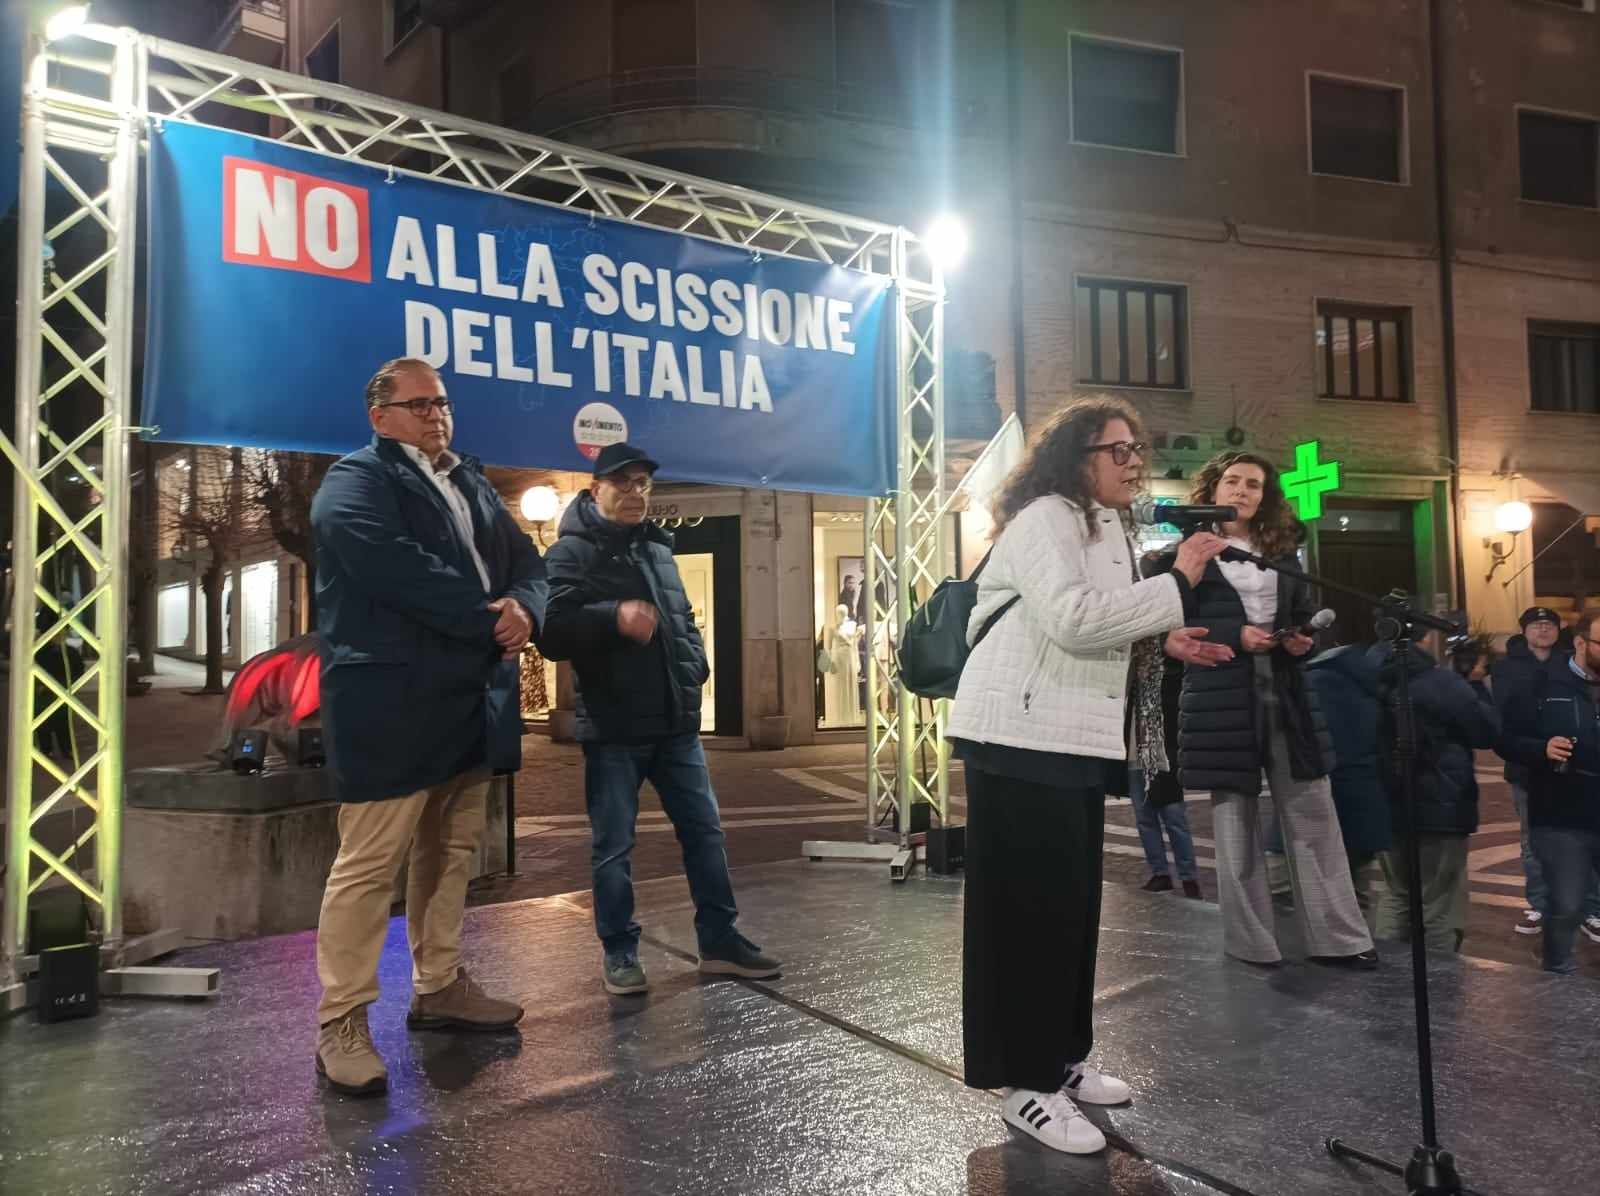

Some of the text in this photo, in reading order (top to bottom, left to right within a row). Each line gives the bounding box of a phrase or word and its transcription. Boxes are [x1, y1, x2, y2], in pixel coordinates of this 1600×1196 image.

[234, 167, 856, 356] NO ALLA SCISSIONE
[405, 300, 775, 413] DELL'ITALIA
